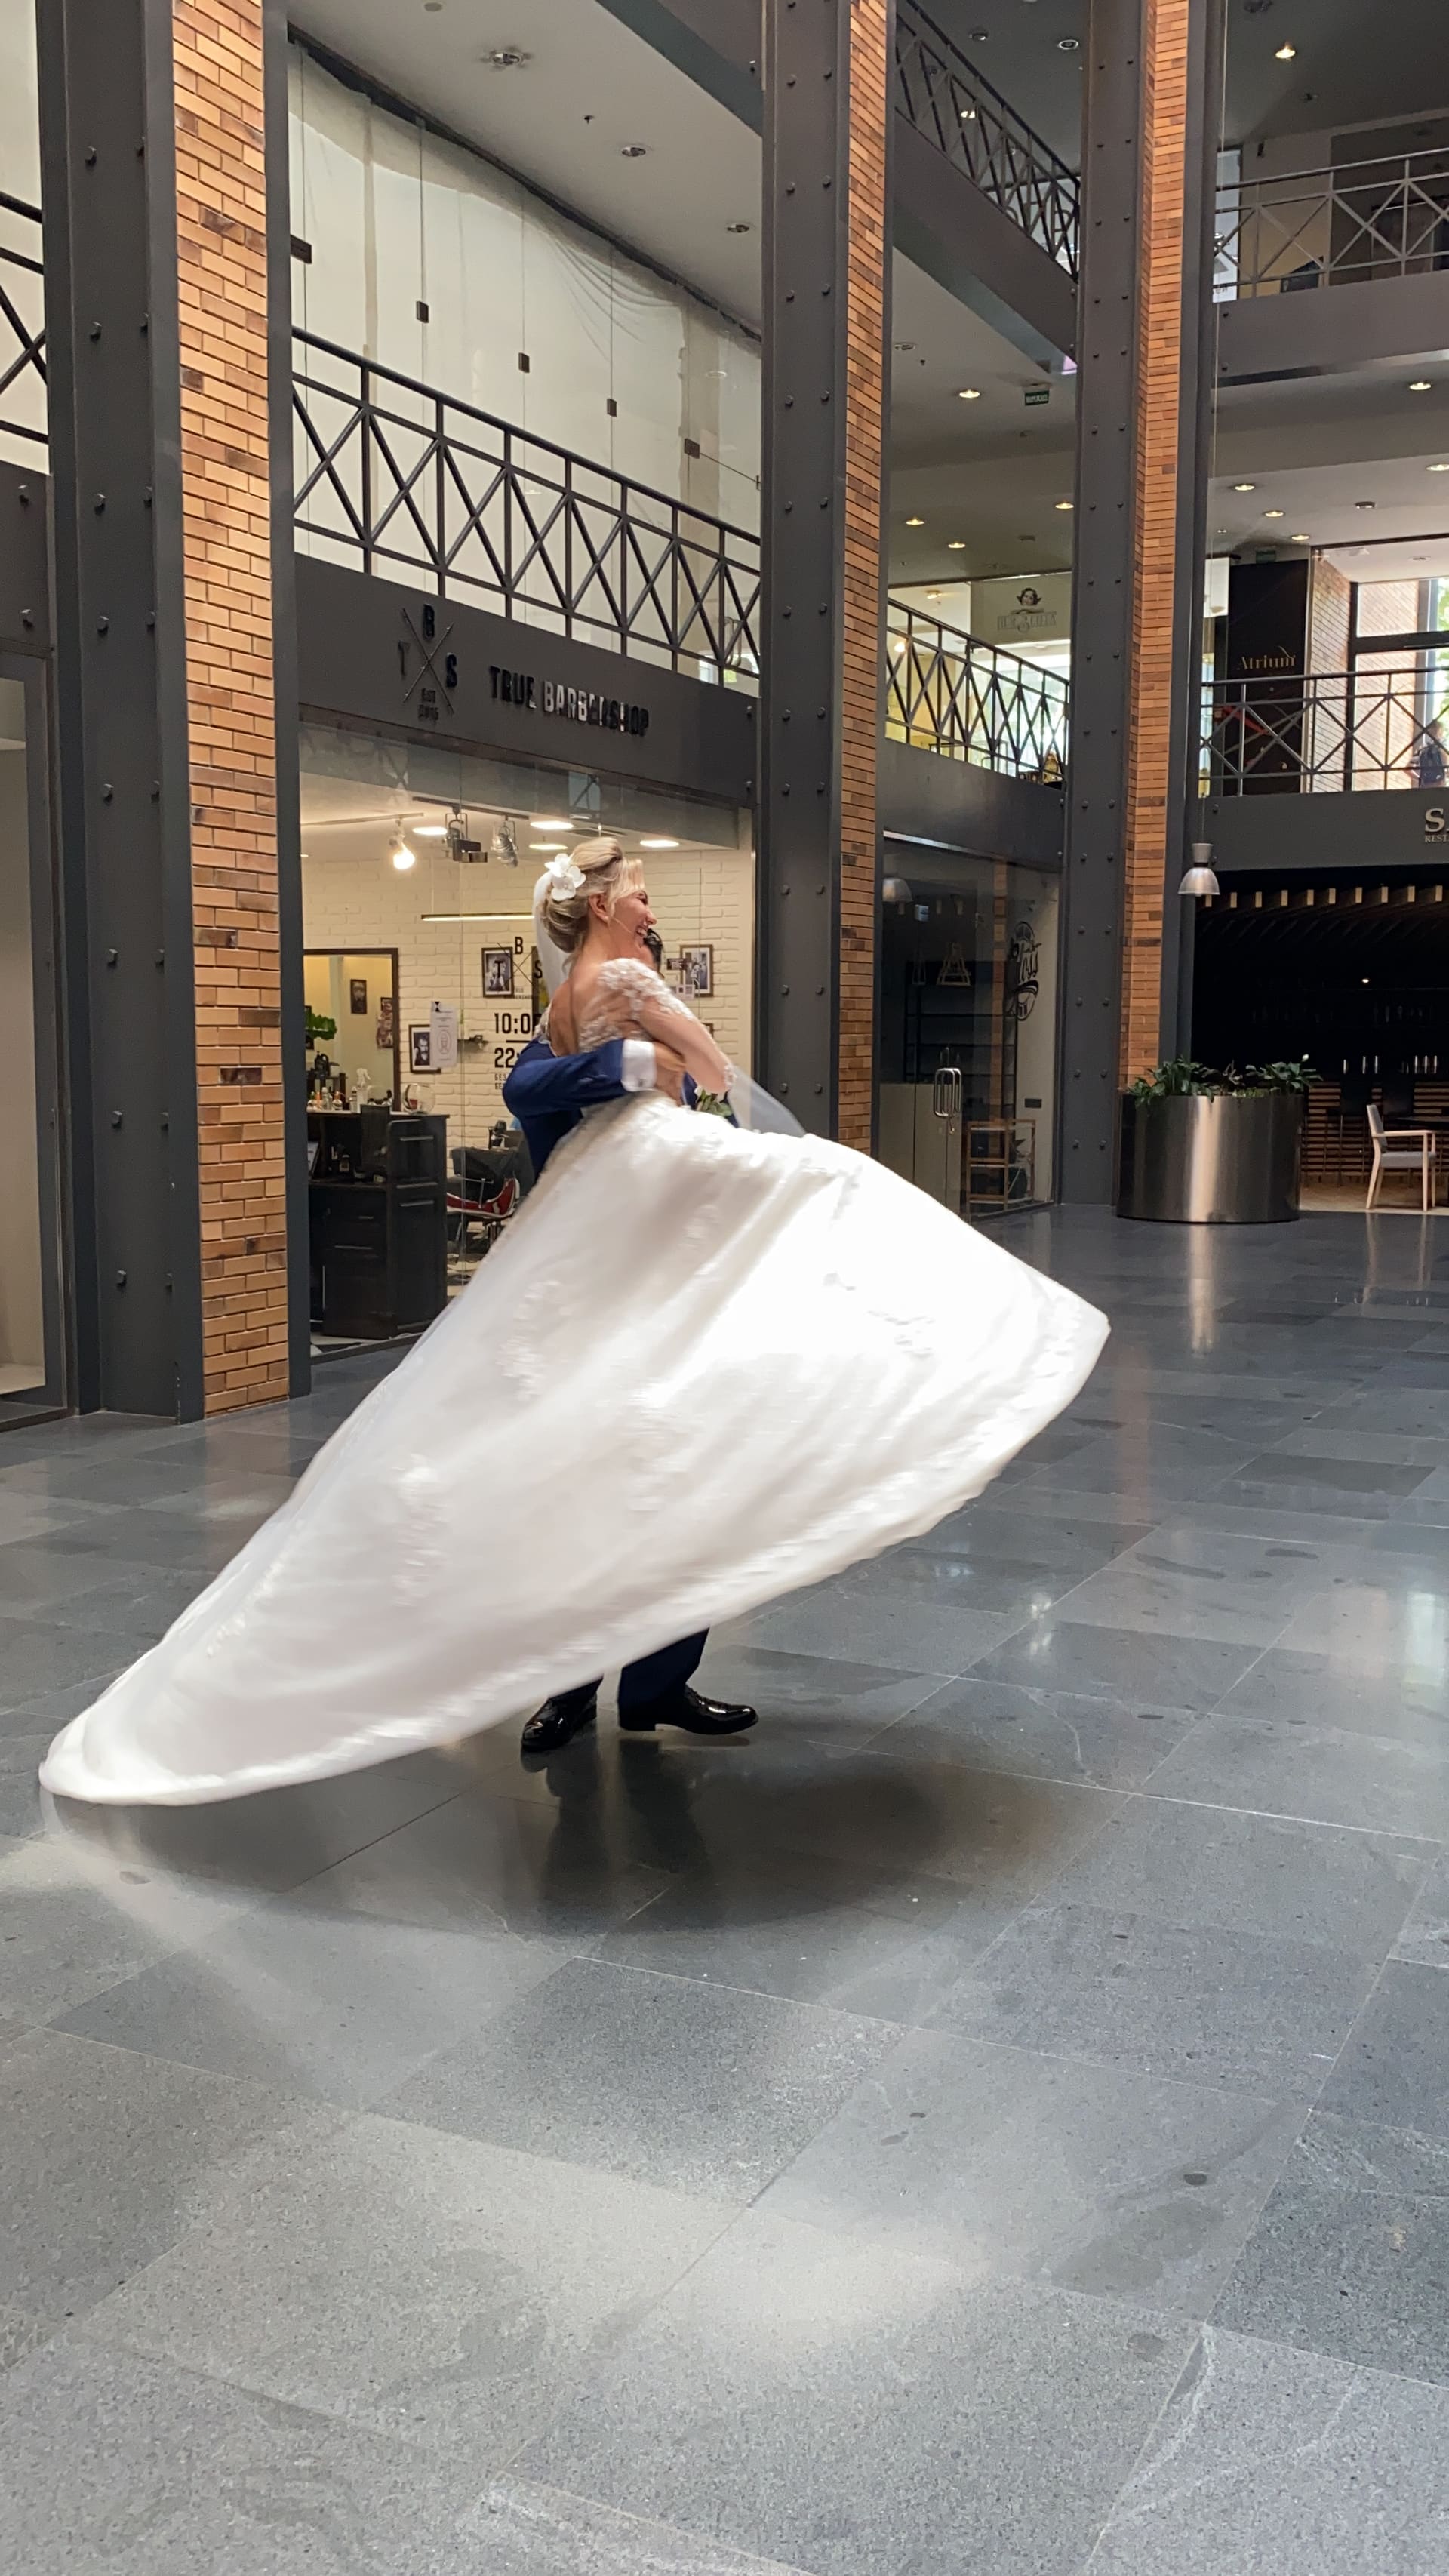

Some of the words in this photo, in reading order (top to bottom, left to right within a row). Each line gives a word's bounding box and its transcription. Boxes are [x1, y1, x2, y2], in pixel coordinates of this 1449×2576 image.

[422, 604, 435, 640] B
[398, 641, 411, 678] T
[446, 653, 457, 688] S
[1237, 651, 1297, 670] Atrium
[489, 665, 537, 709] TRUE
[543, 679, 649, 737] BARBERSHOP
[1425, 808, 1449, 833] S
[1425, 834, 1449, 843] REST
[515, 936, 524, 955] B
[494, 959, 504, 979] T
[534, 959, 543, 979] S
